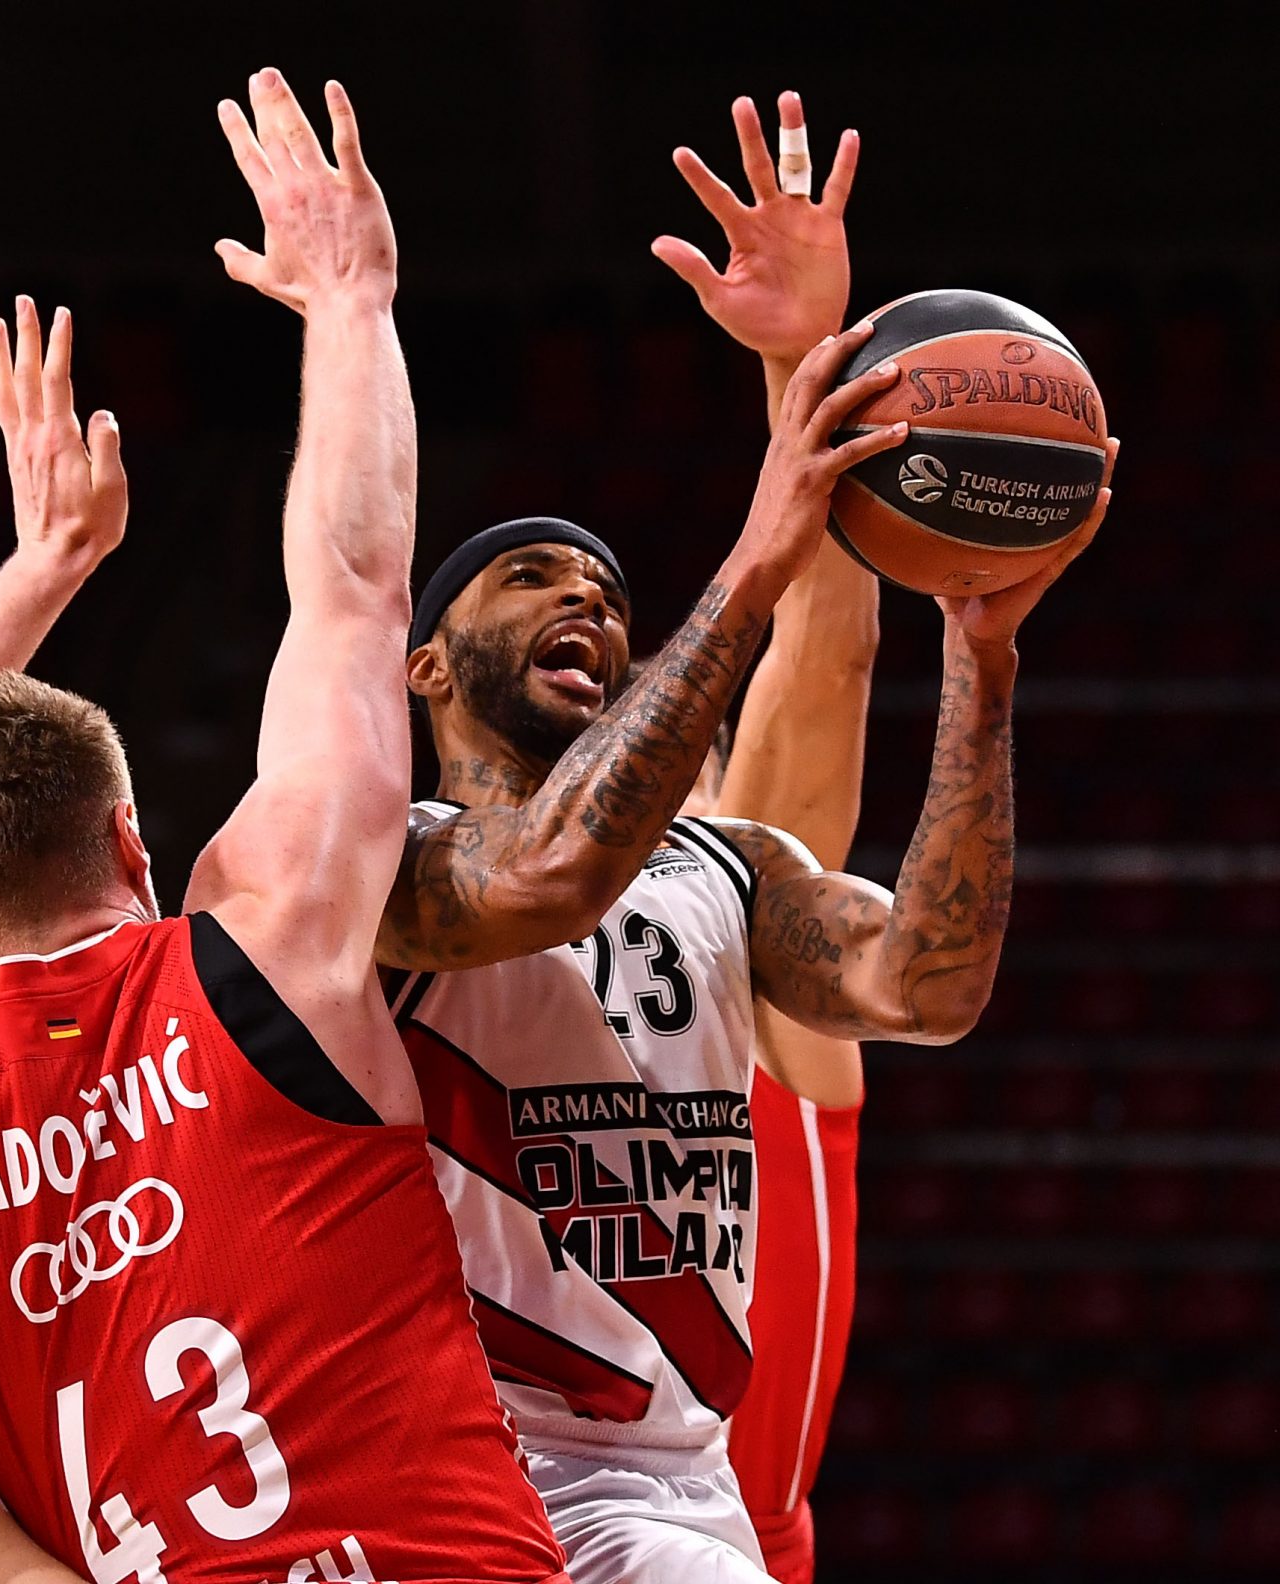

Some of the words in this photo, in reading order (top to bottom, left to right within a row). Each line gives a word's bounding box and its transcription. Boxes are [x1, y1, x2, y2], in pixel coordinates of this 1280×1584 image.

[910, 368, 1098, 433] SPALDING
[952, 491, 1070, 525] EuroLeague
[960, 471, 1040, 499] TURKISH
[519, 1093, 647, 1126] ARMANI
[516, 1140, 752, 1211] OLIMPIA
[55, 1317, 291, 1584] 43
